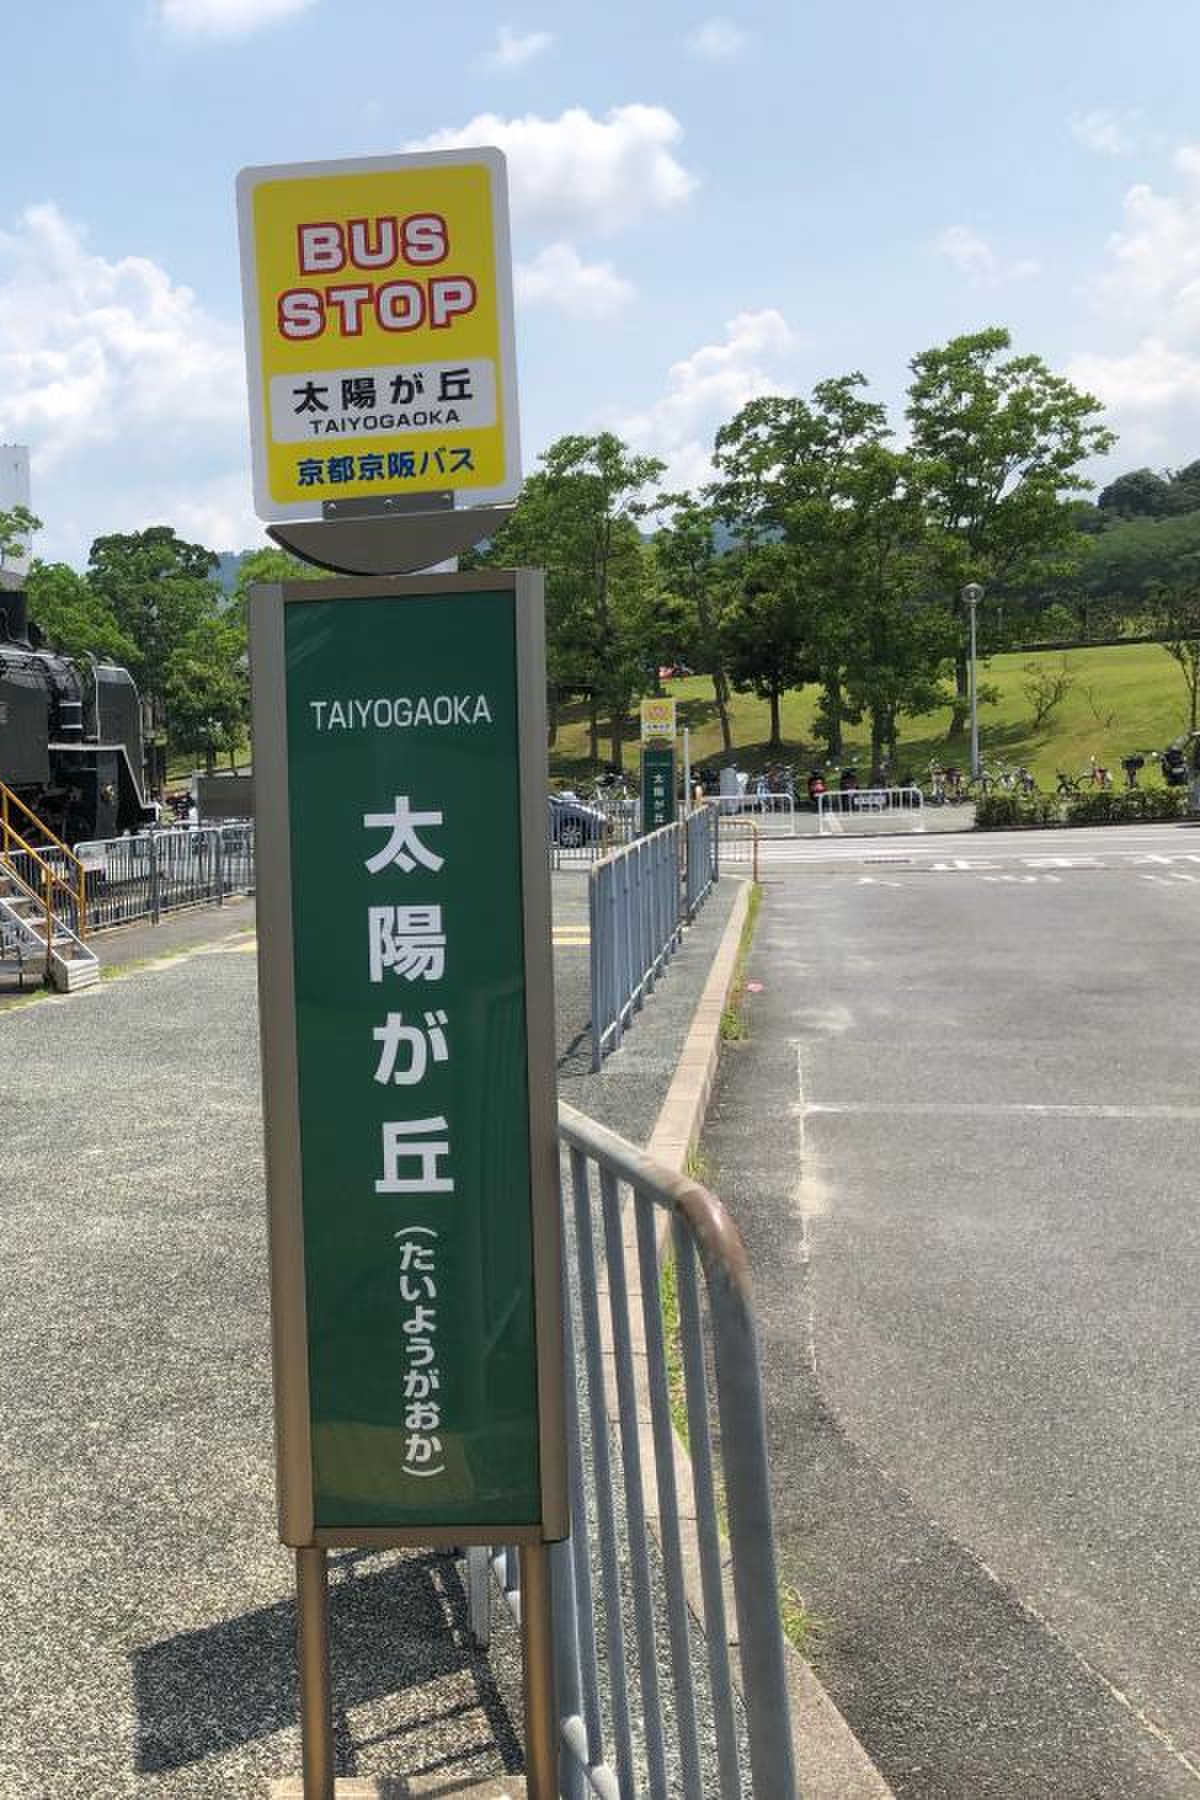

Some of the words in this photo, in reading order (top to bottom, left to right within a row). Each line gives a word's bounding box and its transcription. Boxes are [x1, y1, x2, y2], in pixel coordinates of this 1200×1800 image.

[297, 213, 449, 275] BUS
[279, 276, 477, 340] STOP
[293, 367, 473, 414] 太陽が丘
[309, 408, 460, 435] TAIYOGAOKA
[296, 447, 475, 487] 京都京阪バス
[310, 695, 493, 731] TAIYOGAOKA
[363, 796, 455, 1193] 太陽が丘
